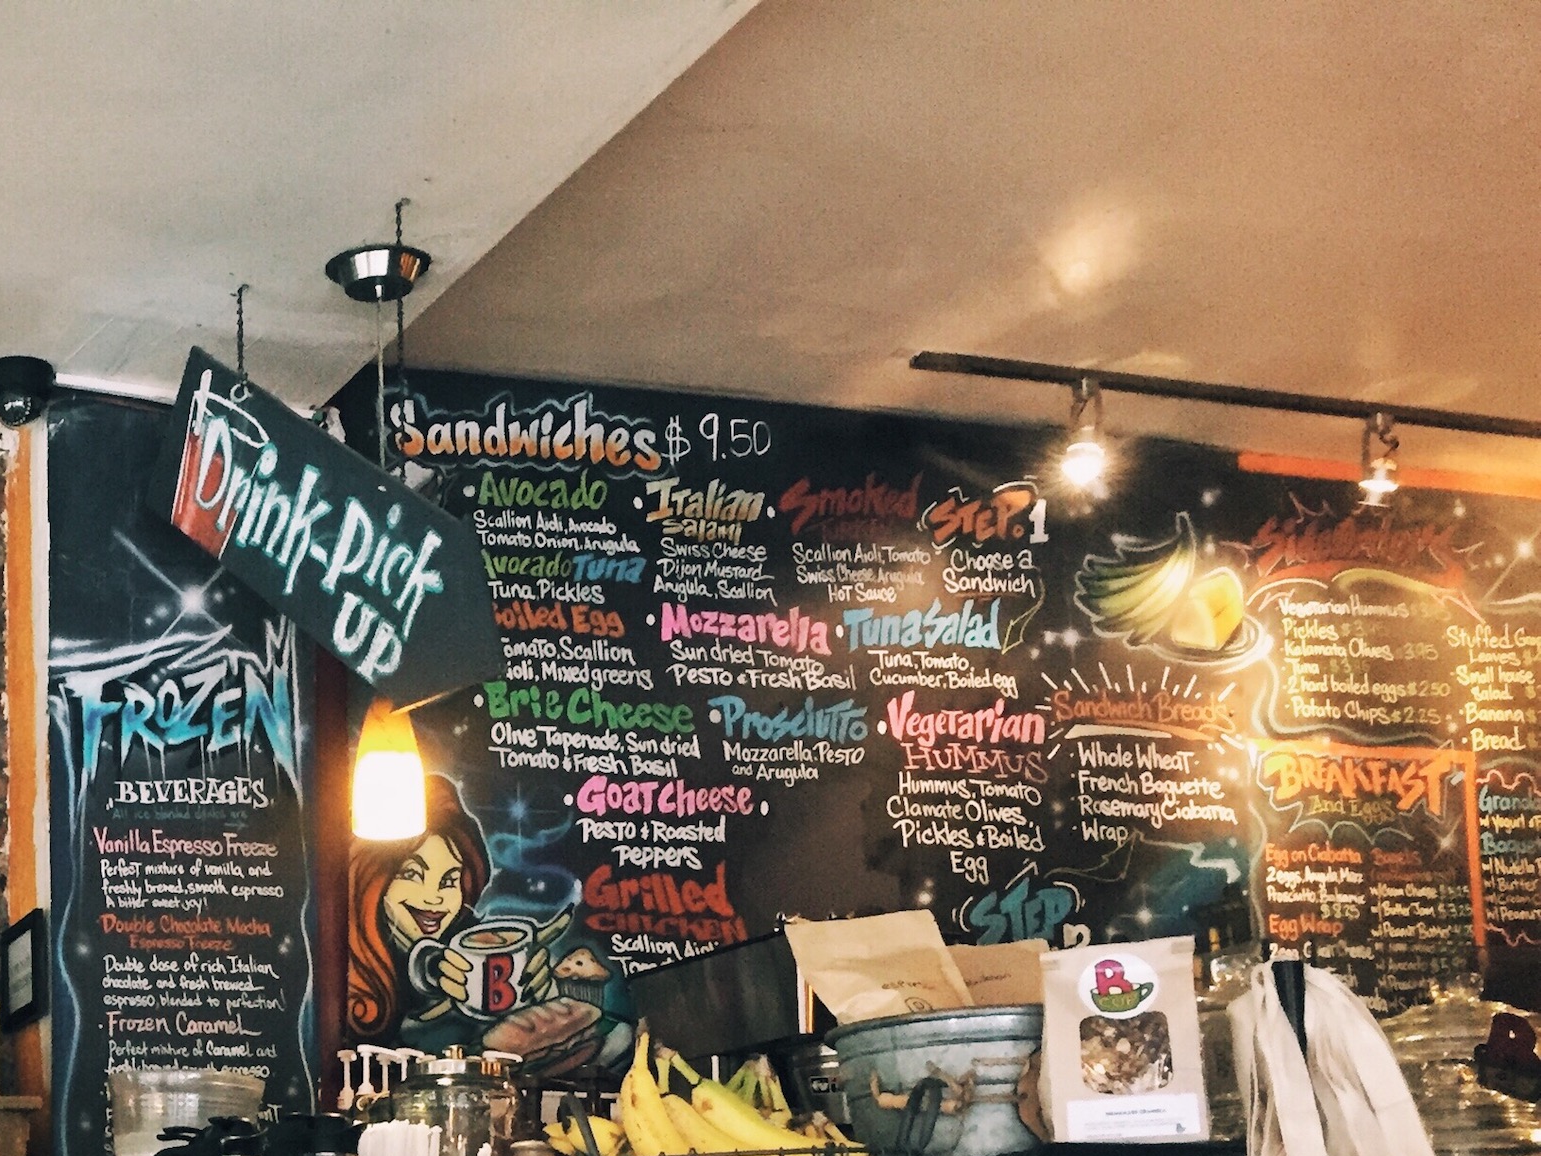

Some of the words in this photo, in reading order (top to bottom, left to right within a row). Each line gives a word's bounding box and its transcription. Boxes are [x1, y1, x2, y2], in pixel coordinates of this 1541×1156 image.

[390, 399, 661, 470] Sandwiches
[477, 469, 608, 510] Avocado
[646, 477, 766, 522] Italian
[473, 511, 532, 530] Scallion
[569, 522, 617, 535] Avocado
[1029, 499, 1050, 544] 1
[660, 537, 709, 560] Swiss
[711, 543, 767, 562] Cheese
[792, 542, 853, 566] Scallion
[881, 546, 931, 565] Tomato
[950, 548, 1013, 572] Choose
[572, 554, 646, 583] Tuna
[657, 559, 704, 581] Dijon
[705, 560, 774, 582] Mustard
[797, 566, 835, 585] Swiss
[537, 582, 605, 603] Pickles
[856, 586, 897, 603] Sauce
[943, 570, 1035, 598] Sandwich
[570, 603, 626, 638] Egg
[661, 602, 832, 657] Mozzarella
[843, 608, 923, 650] Tuna
[922, 597, 1002, 650] Salad
[1282, 617, 1339, 641] Pickles
[1446, 622, 1514, 649] Stuffed
[559, 640, 635, 665] Scallion
[670, 641, 708, 662] Sun
[710, 640, 753, 664] dried
[756, 648, 825, 676] Tomato
[540, 661, 590, 683] Mixed
[590, 666, 653, 691] greens
[747, 669, 801, 690] Fresh
[805, 665, 857, 691] Basil
[947, 671, 993, 691] Boiled
[993, 674, 1017, 699] egg
[1330, 673, 1370, 695] boiled
[56, 650, 301, 778] FROZEN
[483, 680, 563, 719] Brie
[566, 687, 696, 732] Cheese
[708, 696, 868, 743] Prosciutto
[886, 690, 1045, 748] Vegetarian
[1055, 691, 1151, 720] Sandwich
[1291, 696, 1341, 718] Potato
[1344, 701, 1391, 725] Chips
[1465, 702, 1525, 724] Banana
[491, 722, 536, 748] Olive
[627, 729, 657, 754] Sun
[660, 734, 701, 759] dried
[1470, 726, 1526, 752] Bread
[489, 747, 559, 769] Tomato
[574, 753, 628, 776] Fresh
[631, 755, 678, 778] Basil
[1077, 742, 1134, 771] Whole
[732, 764, 753, 776] and
[756, 764, 819, 787] Arugula
[1077, 771, 1140, 796] French
[1140, 773, 1225, 802] Baguette
[1264, 753, 1460, 817] BREAKFAST
[114, 776, 268, 809] BEVERAGES
[658, 780, 753, 817] Cheese
[970, 780, 1042, 806] Tomato
[1078, 797, 1162, 828] Rosemary
[92, 826, 150, 855] Vanilla
[152, 829, 224, 859] Espresso
[223, 832, 279, 858] Freeze
[652, 816, 726, 844] Roasted
[893, 819, 975, 848] Pickles
[984, 825, 1045, 852] Boiled
[1081, 823, 1129, 845] Wrap
[145, 863, 185, 876] mixture
[190, 861, 202, 877] of
[249, 862, 273, 876] and
[611, 844, 702, 870] Peppers
[950, 851, 989, 885] Egg
[1265, 843, 1289, 868] Egg
[100, 879, 142, 900] freshly
[187, 881, 228, 897] smooth
[231, 884, 285, 902] espresso
[582, 860, 735, 918] Grilled
[99, 913, 156, 934] Double
[160, 914, 222, 934] Chocolate
[970, 877, 1074, 946] STEP
[1269, 914, 1298, 941] Egg
[130, 936, 184, 951] Espresso
[103, 954, 146, 974] Double
[149, 956, 180, 972] dose
[184, 952, 200, 973] of
[200, 958, 227, 974] rich
[226, 954, 280, 979] Italian
[102, 976, 152, 990] chocolate
[156, 976, 176, 989] and
[180, 976, 210, 990] fresh
[212, 976, 265, 991] brewed
[160, 993, 203, 1008] blended
[207, 995, 220, 1008] to
[106, 1012, 170, 1037] Frozen
[176, 1011, 262, 1037] Caramel
[108, 1042, 148, 1058] Perfect
[206, 1041, 250, 1058] Caramel
